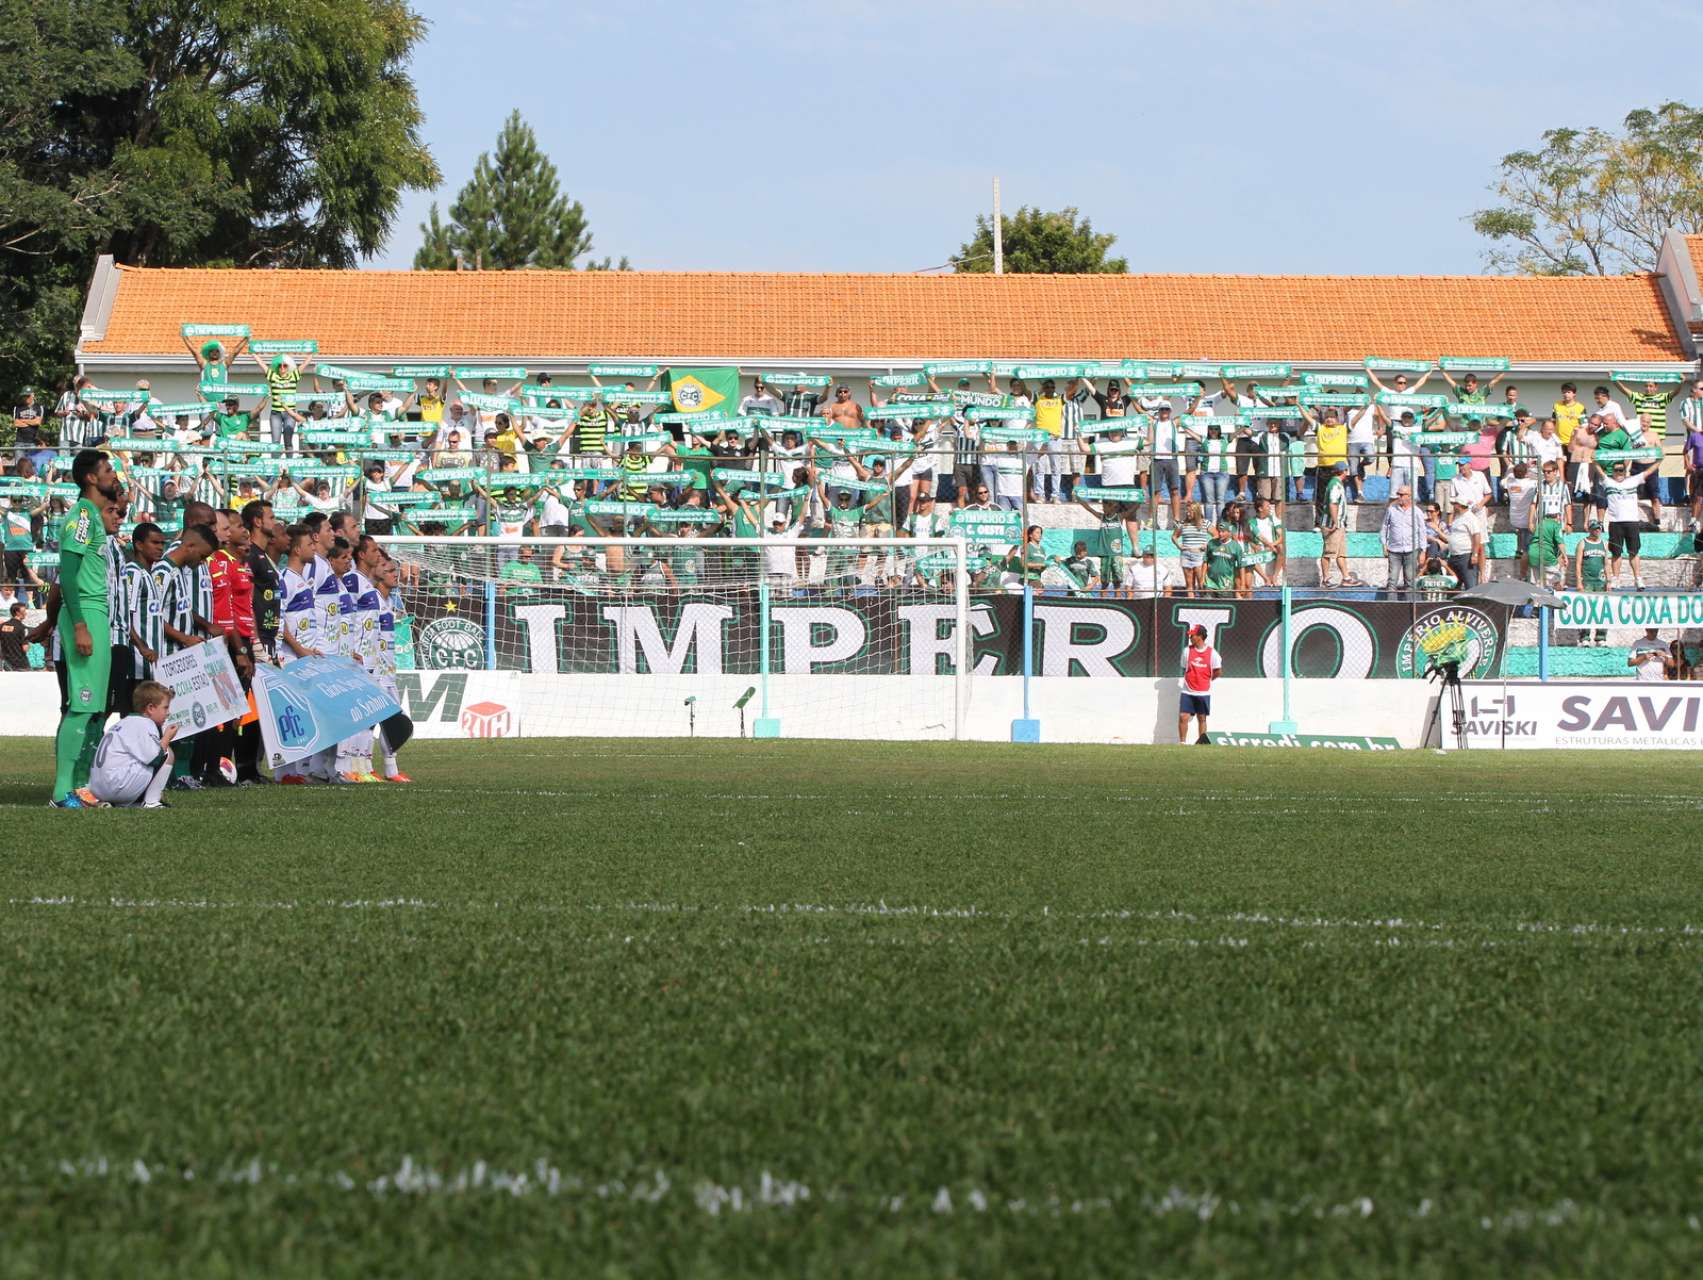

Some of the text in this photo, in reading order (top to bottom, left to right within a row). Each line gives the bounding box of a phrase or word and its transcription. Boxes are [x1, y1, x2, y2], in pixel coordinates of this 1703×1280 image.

[960, 394, 1001, 407] MUNDO
[1559, 595, 1614, 625] COXA
[1618, 595, 1673, 625] COXA
[436, 648, 478, 668] CFC
[1557, 695, 1701, 732] SAVI
[1556, 736, 1630, 745] ESTRUTURAS
